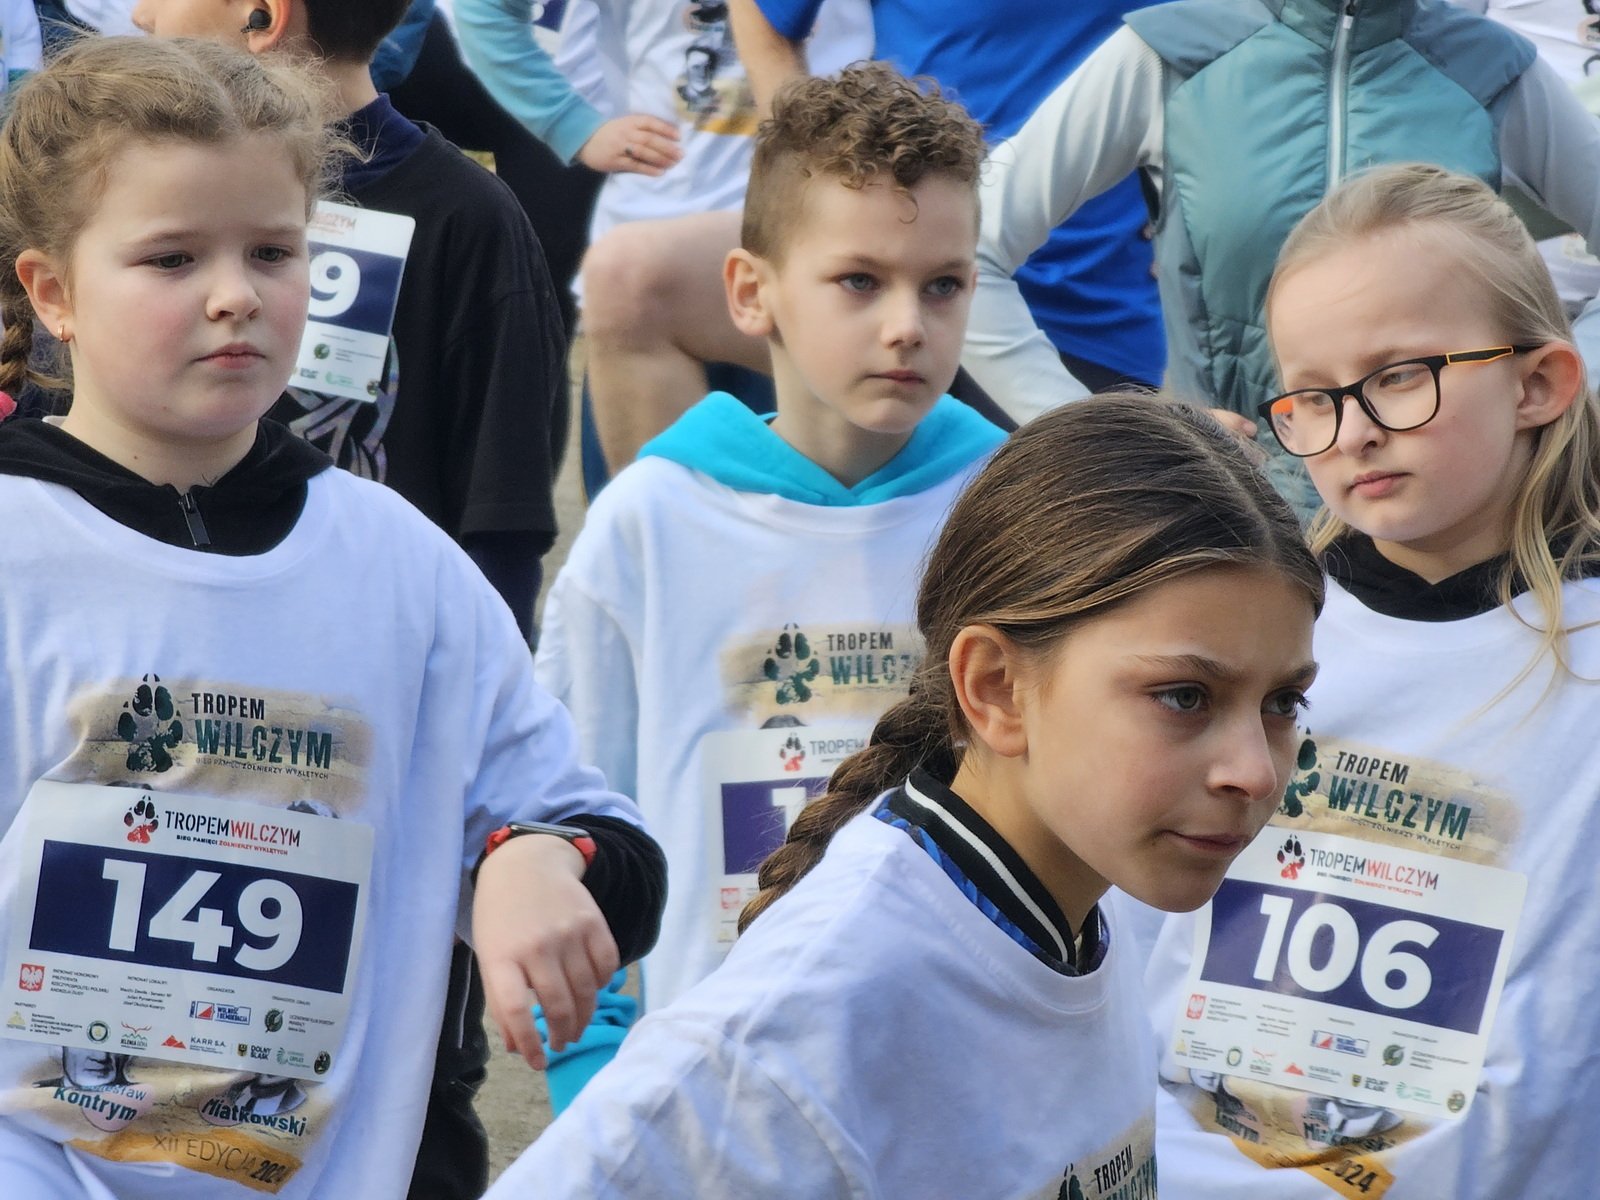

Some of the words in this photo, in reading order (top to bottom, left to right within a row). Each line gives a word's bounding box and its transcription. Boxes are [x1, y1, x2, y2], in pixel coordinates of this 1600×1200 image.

[827, 632, 894, 651] TROPEM
[191, 692, 265, 721] TROPEM
[195, 718, 333, 769] WILCZYM
[1335, 751, 1410, 785] TROPEM
[1328, 775, 1472, 841] WILCZYM
[176, 834, 192, 843] BIEG
[102, 858, 303, 972] 149
[1253, 893, 1440, 1010] 106
[190, 1036, 213, 1046] KARR
[53, 1086, 138, 1121] Kontrym
[201, 1097, 307, 1137] Miatkowski
[152, 1135, 178, 1152] XII
[1094, 1144, 1134, 1194] TROPEM
